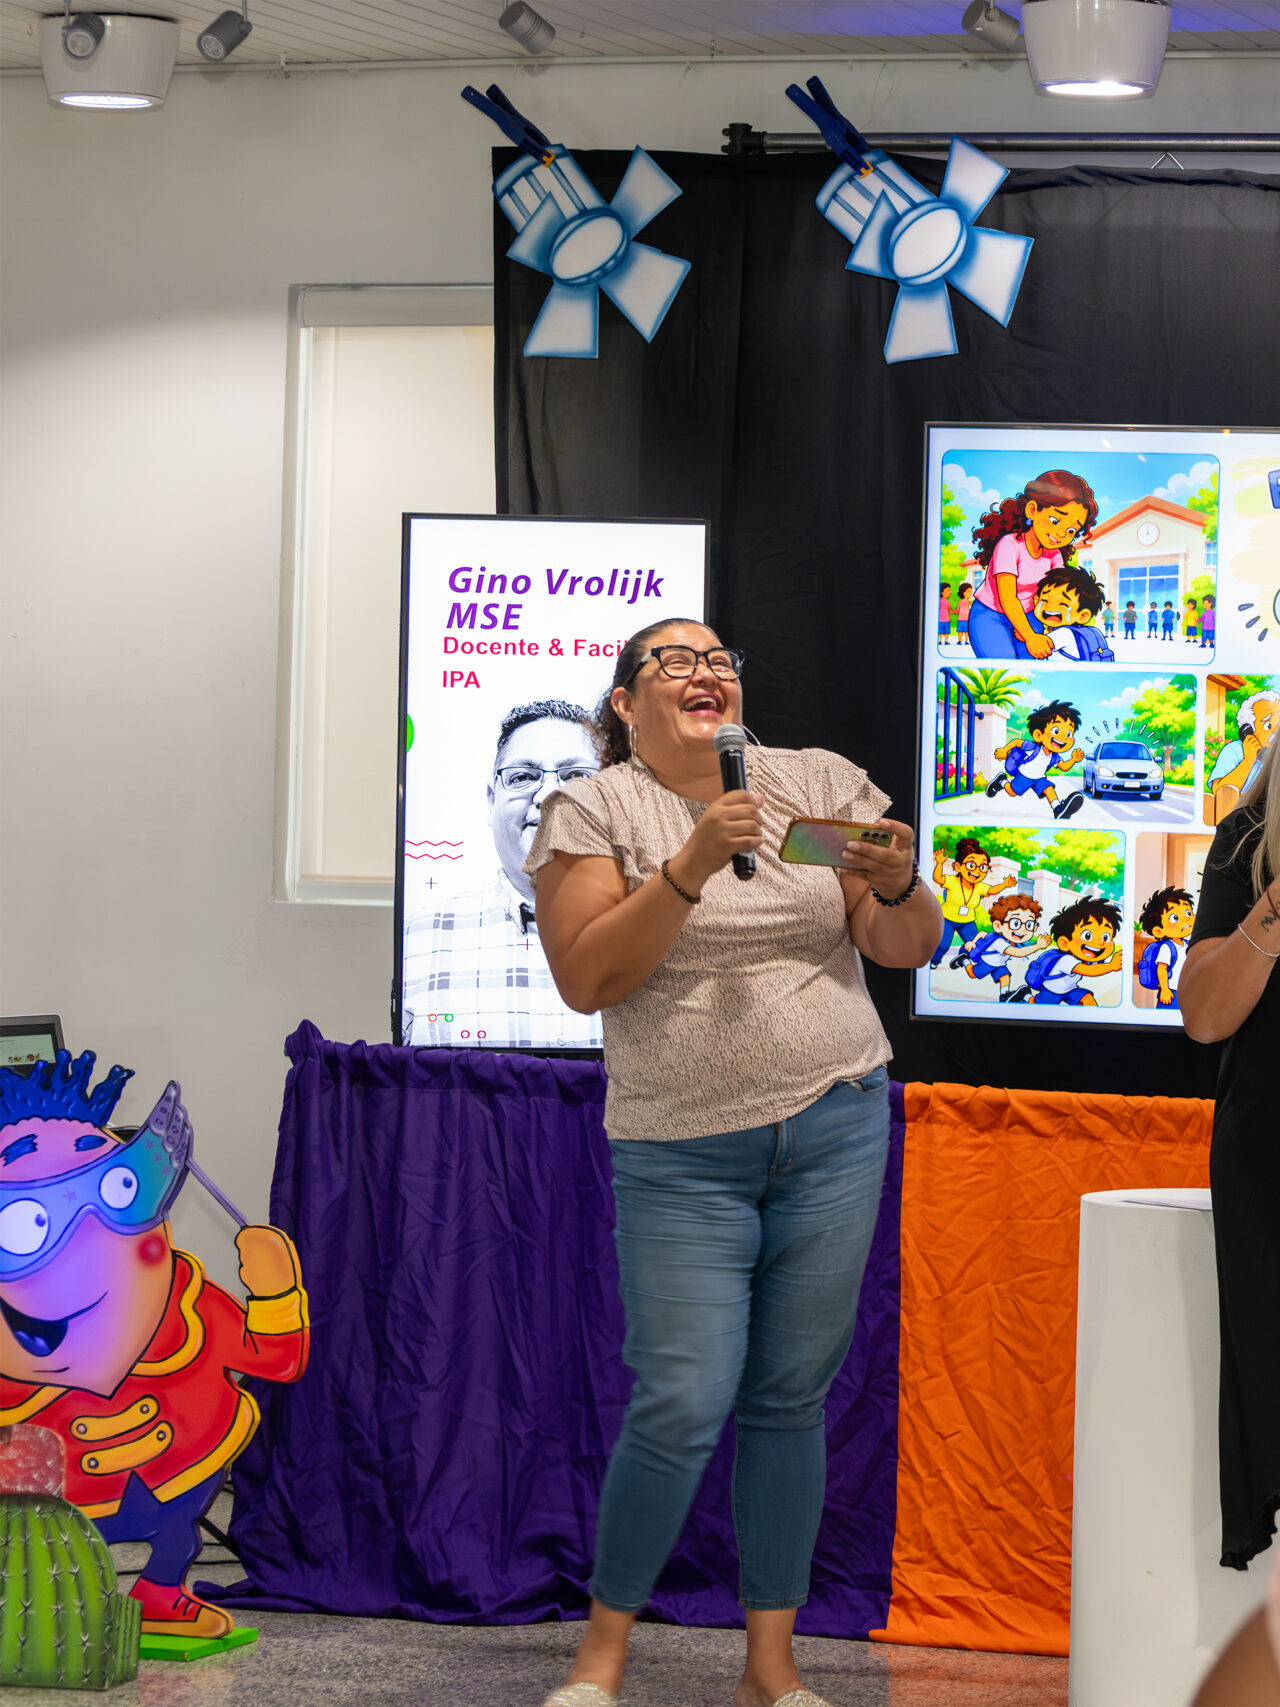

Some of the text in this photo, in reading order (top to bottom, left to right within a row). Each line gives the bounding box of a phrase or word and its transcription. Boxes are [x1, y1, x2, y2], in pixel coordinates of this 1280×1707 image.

[449, 566, 664, 604] Gino Vrolijk
[446, 602, 523, 630] MSE
[443, 636, 628, 657] Docente & Faci
[442, 670, 481, 688] IPA
